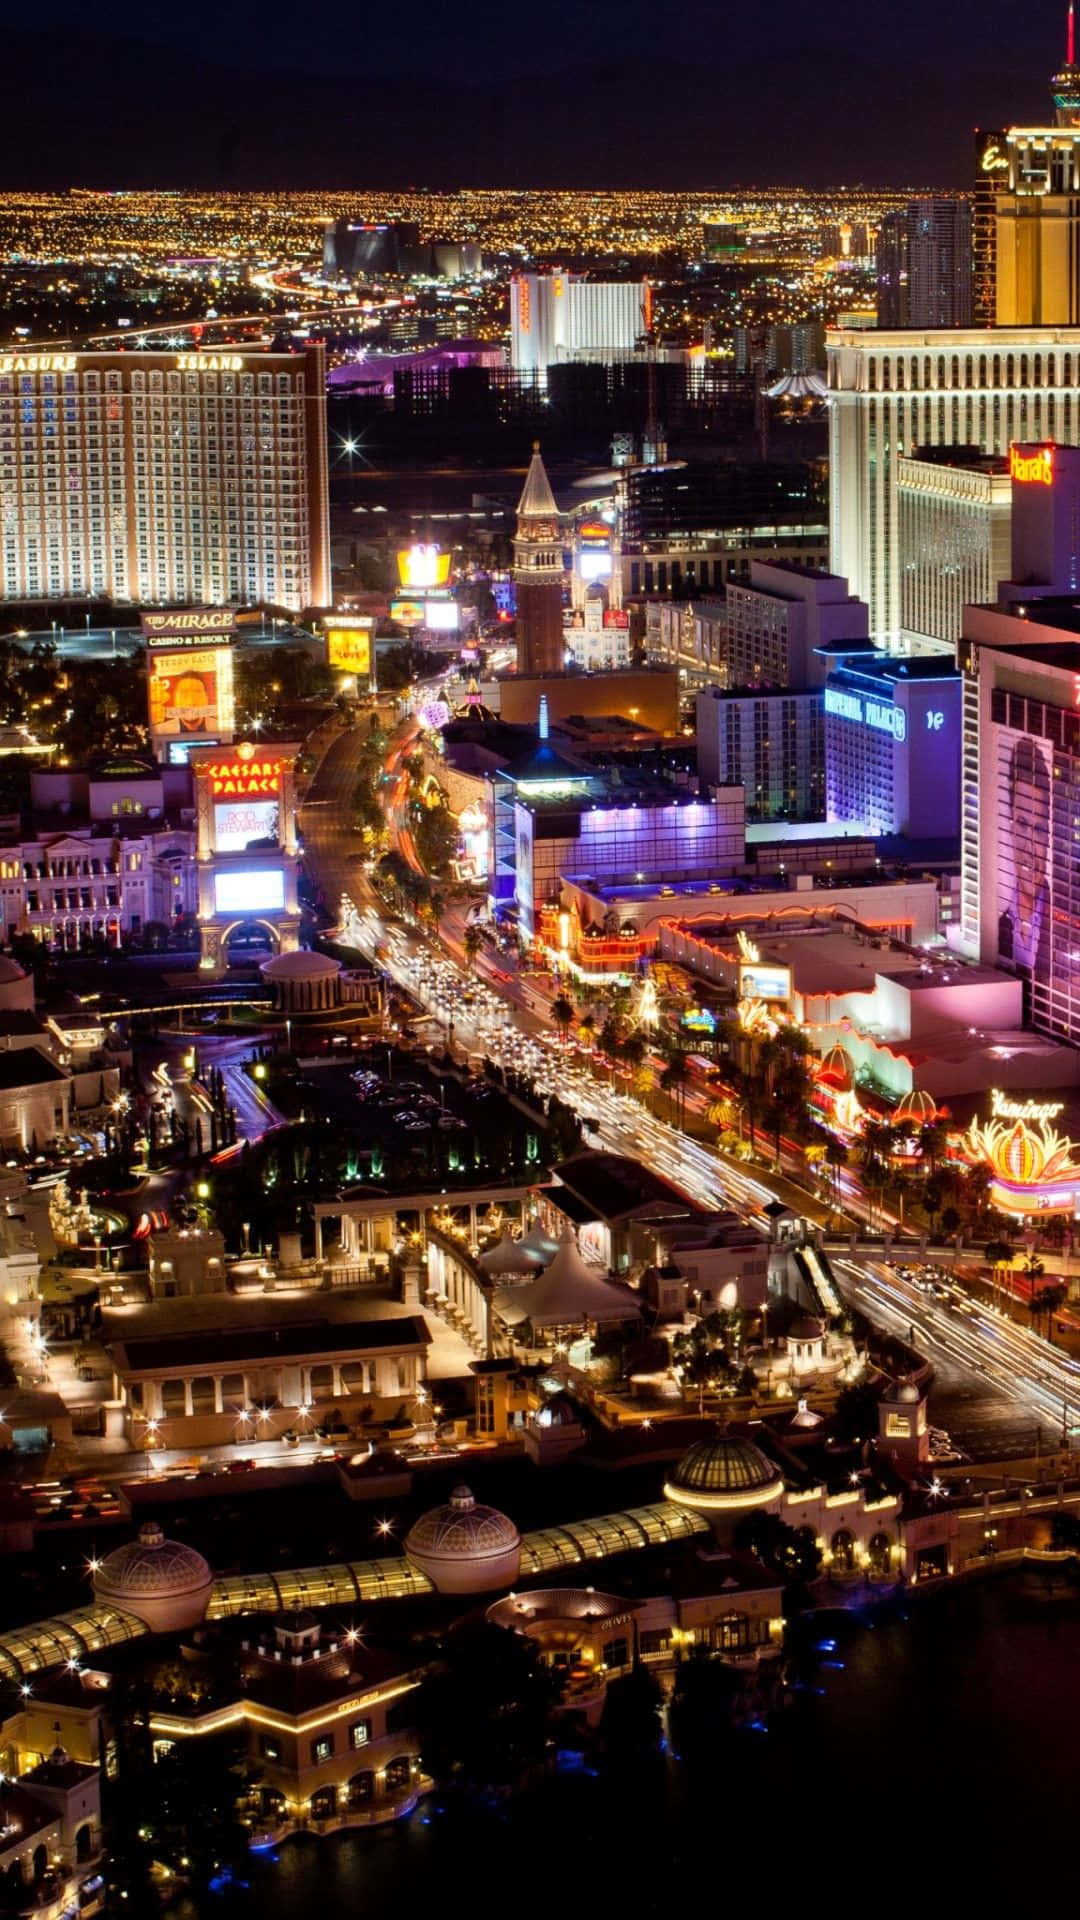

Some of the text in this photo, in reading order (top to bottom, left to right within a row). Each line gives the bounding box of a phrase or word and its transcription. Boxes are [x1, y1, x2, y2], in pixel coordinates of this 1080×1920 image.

[0, 355, 244, 373] EASURE ISLAND
[1010, 447, 1053, 486] Harrah's
[152, 613, 233, 630] MIRAGE
[149, 636, 184, 646] CASINO
[194, 634, 231, 645] RESORT
[209, 763, 281, 779] CAESARS
[213, 778, 279, 794] PALACE
[991, 1088, 1064, 1128] Flamingo
